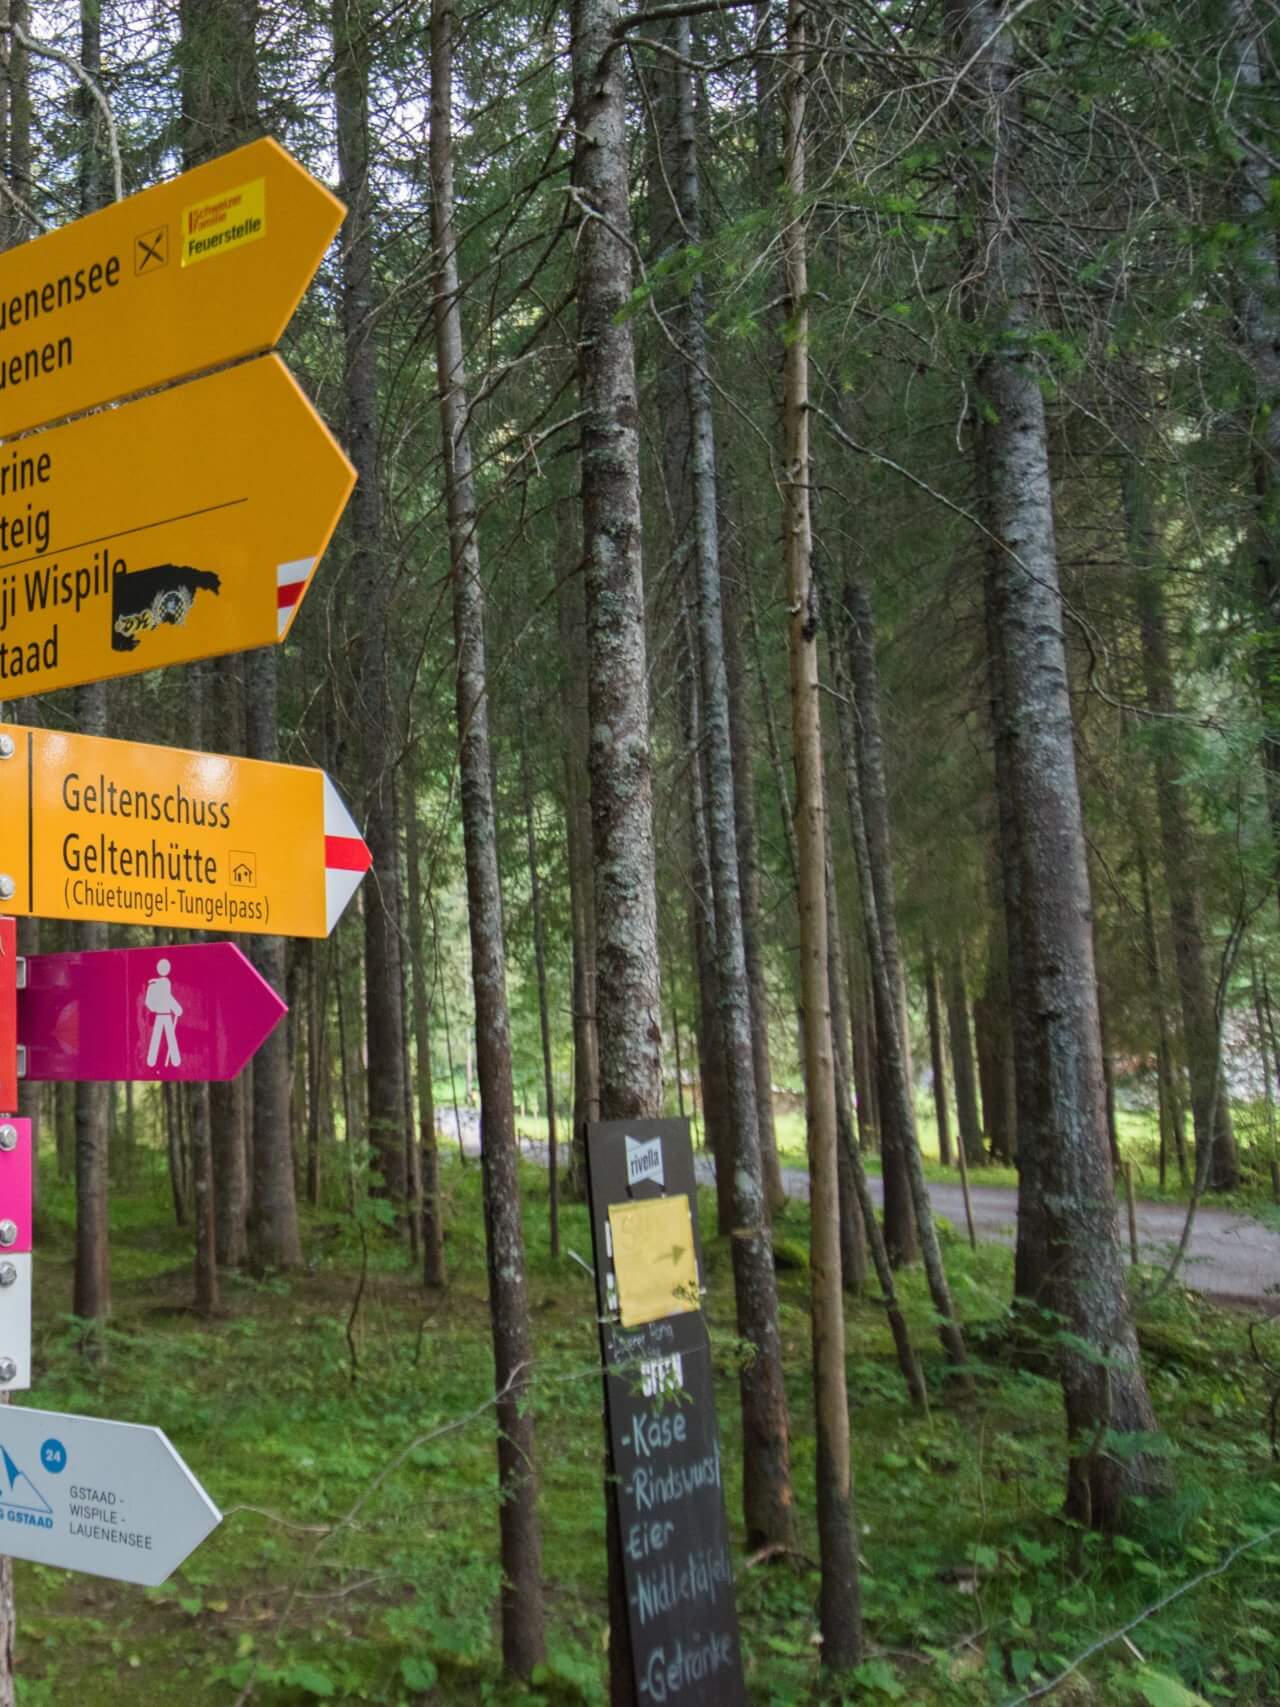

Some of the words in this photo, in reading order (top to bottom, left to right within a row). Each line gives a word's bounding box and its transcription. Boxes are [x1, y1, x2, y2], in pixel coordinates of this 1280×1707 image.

[188, 216, 262, 257] Feuerstelle
[63, 772, 231, 829] Geltenschuss
[63, 832, 218, 885] Geltenhütte
[64, 878, 271, 925] (Chüetungel-Tungelpass)
[630, 1148, 660, 1178] rivella
[44, 1448, 62, 1463] 24
[69, 1486, 117, 1506] GSTAAD
[7, 1510, 54, 1529] GSTAAD
[69, 1504, 118, 1525] WISPILE
[69, 1522, 153, 1550] LAUENENSEE
